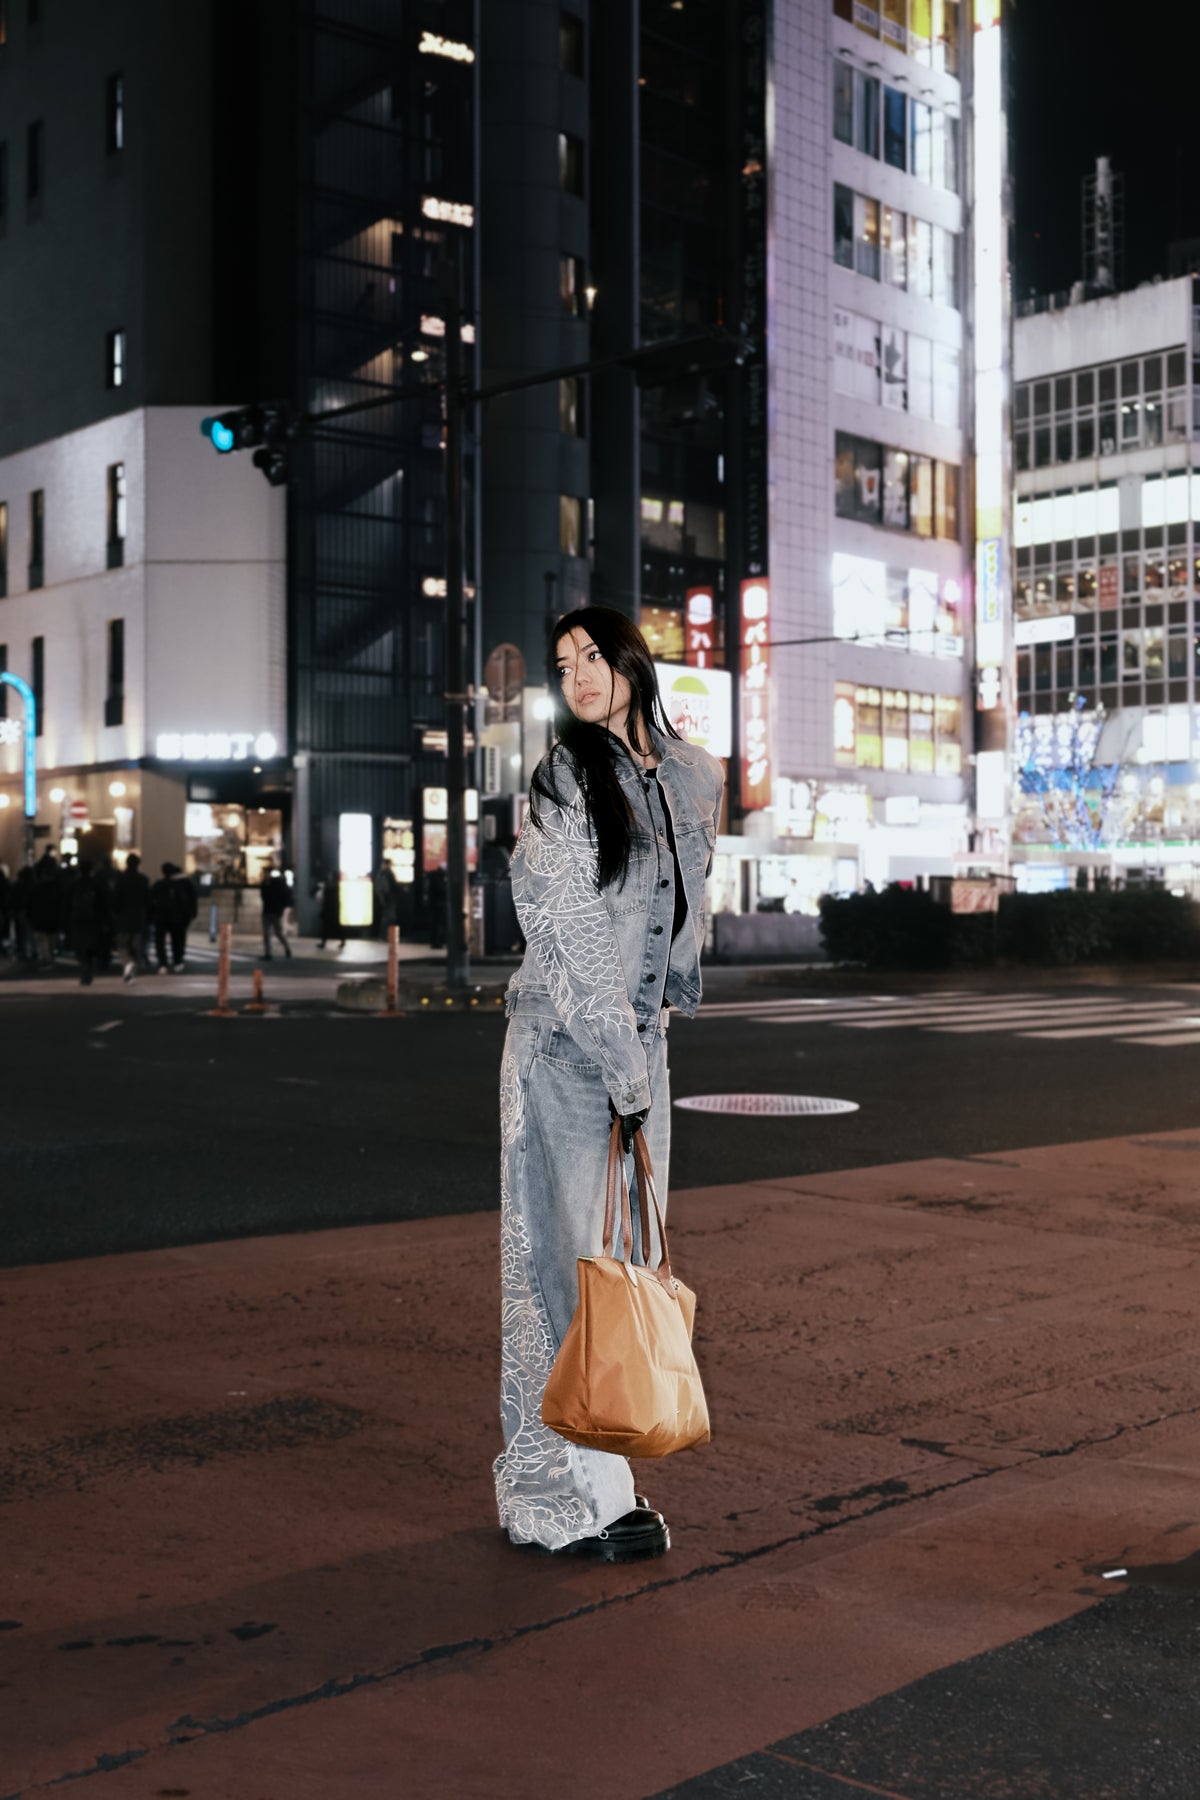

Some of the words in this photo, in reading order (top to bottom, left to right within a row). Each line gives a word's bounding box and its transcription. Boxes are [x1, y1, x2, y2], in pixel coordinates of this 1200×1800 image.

[744, 621, 768, 786] バーガーキング
